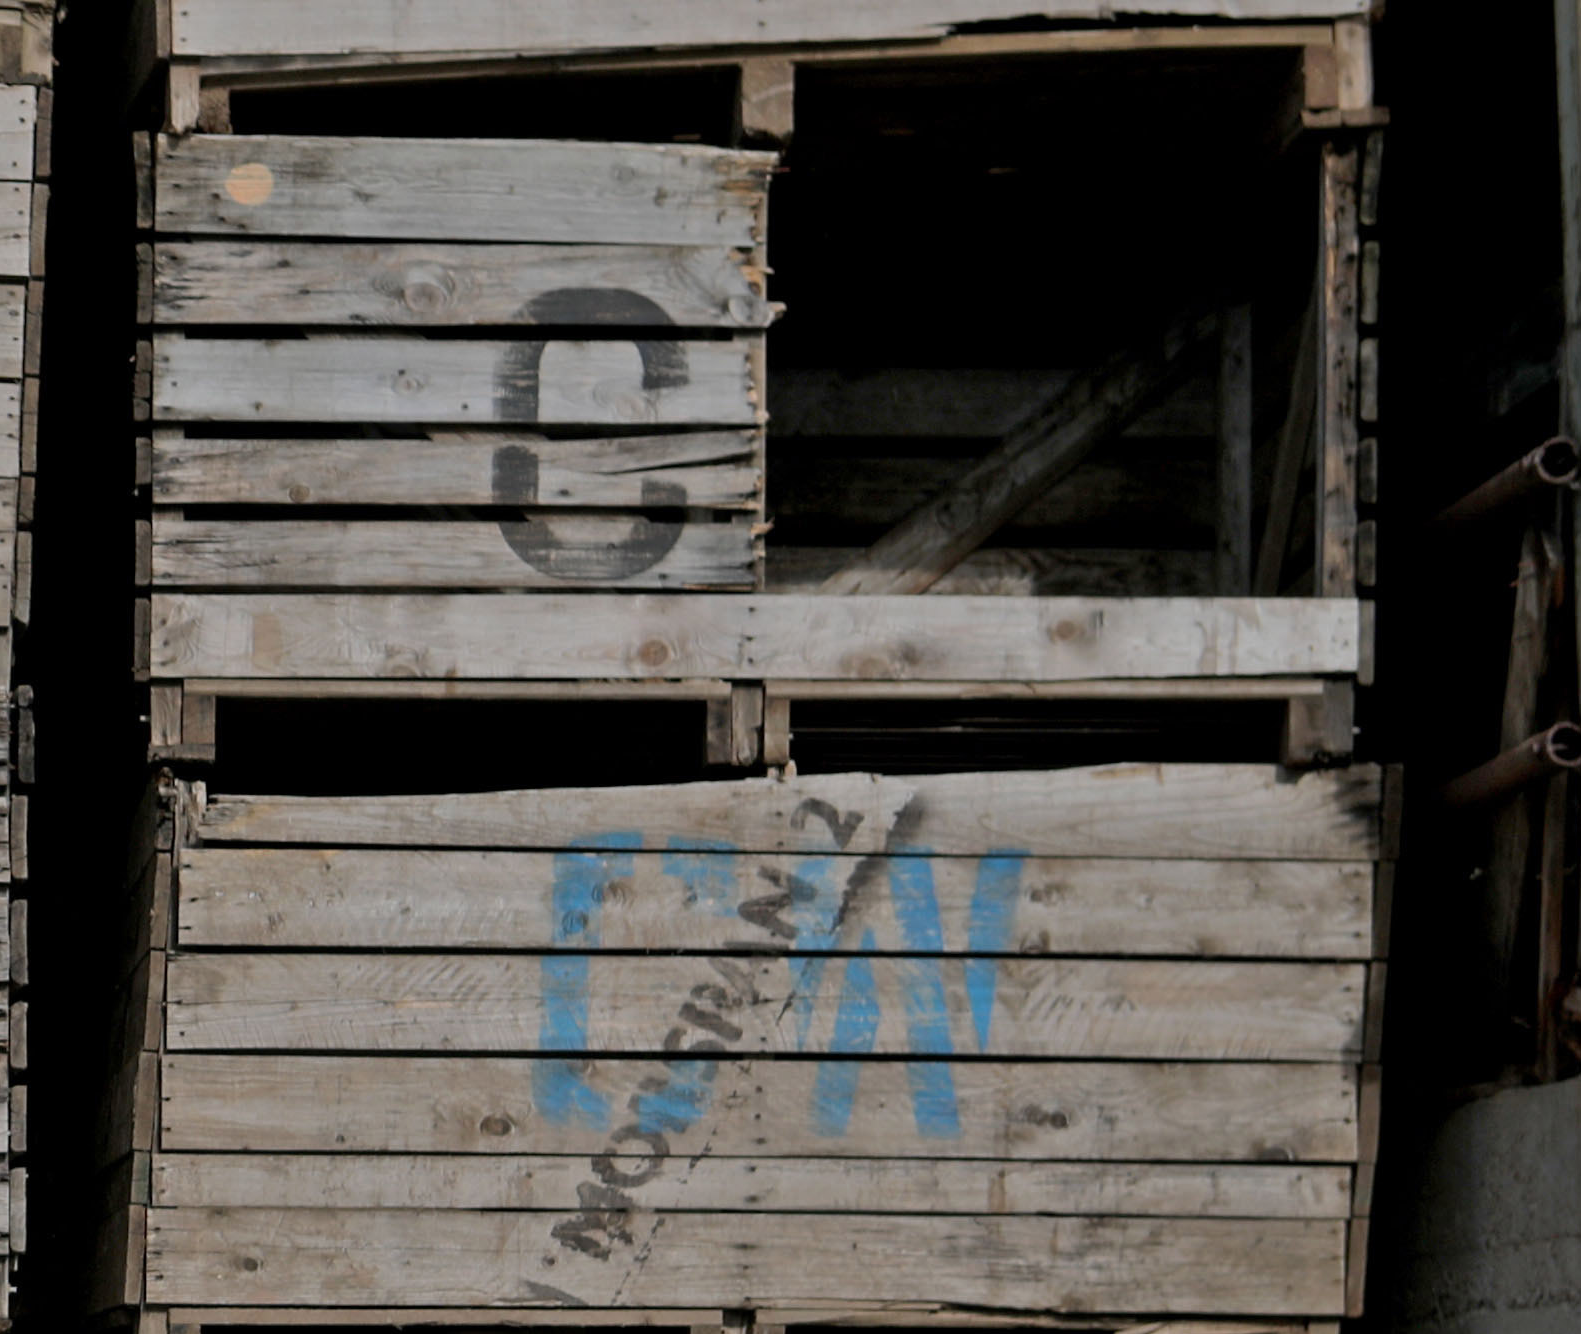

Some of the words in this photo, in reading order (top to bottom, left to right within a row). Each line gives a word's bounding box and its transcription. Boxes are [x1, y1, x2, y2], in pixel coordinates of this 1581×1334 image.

[491, 287, 690, 580] C
[790, 798, 864, 848] 2
[531, 830, 1033, 1140] CW
